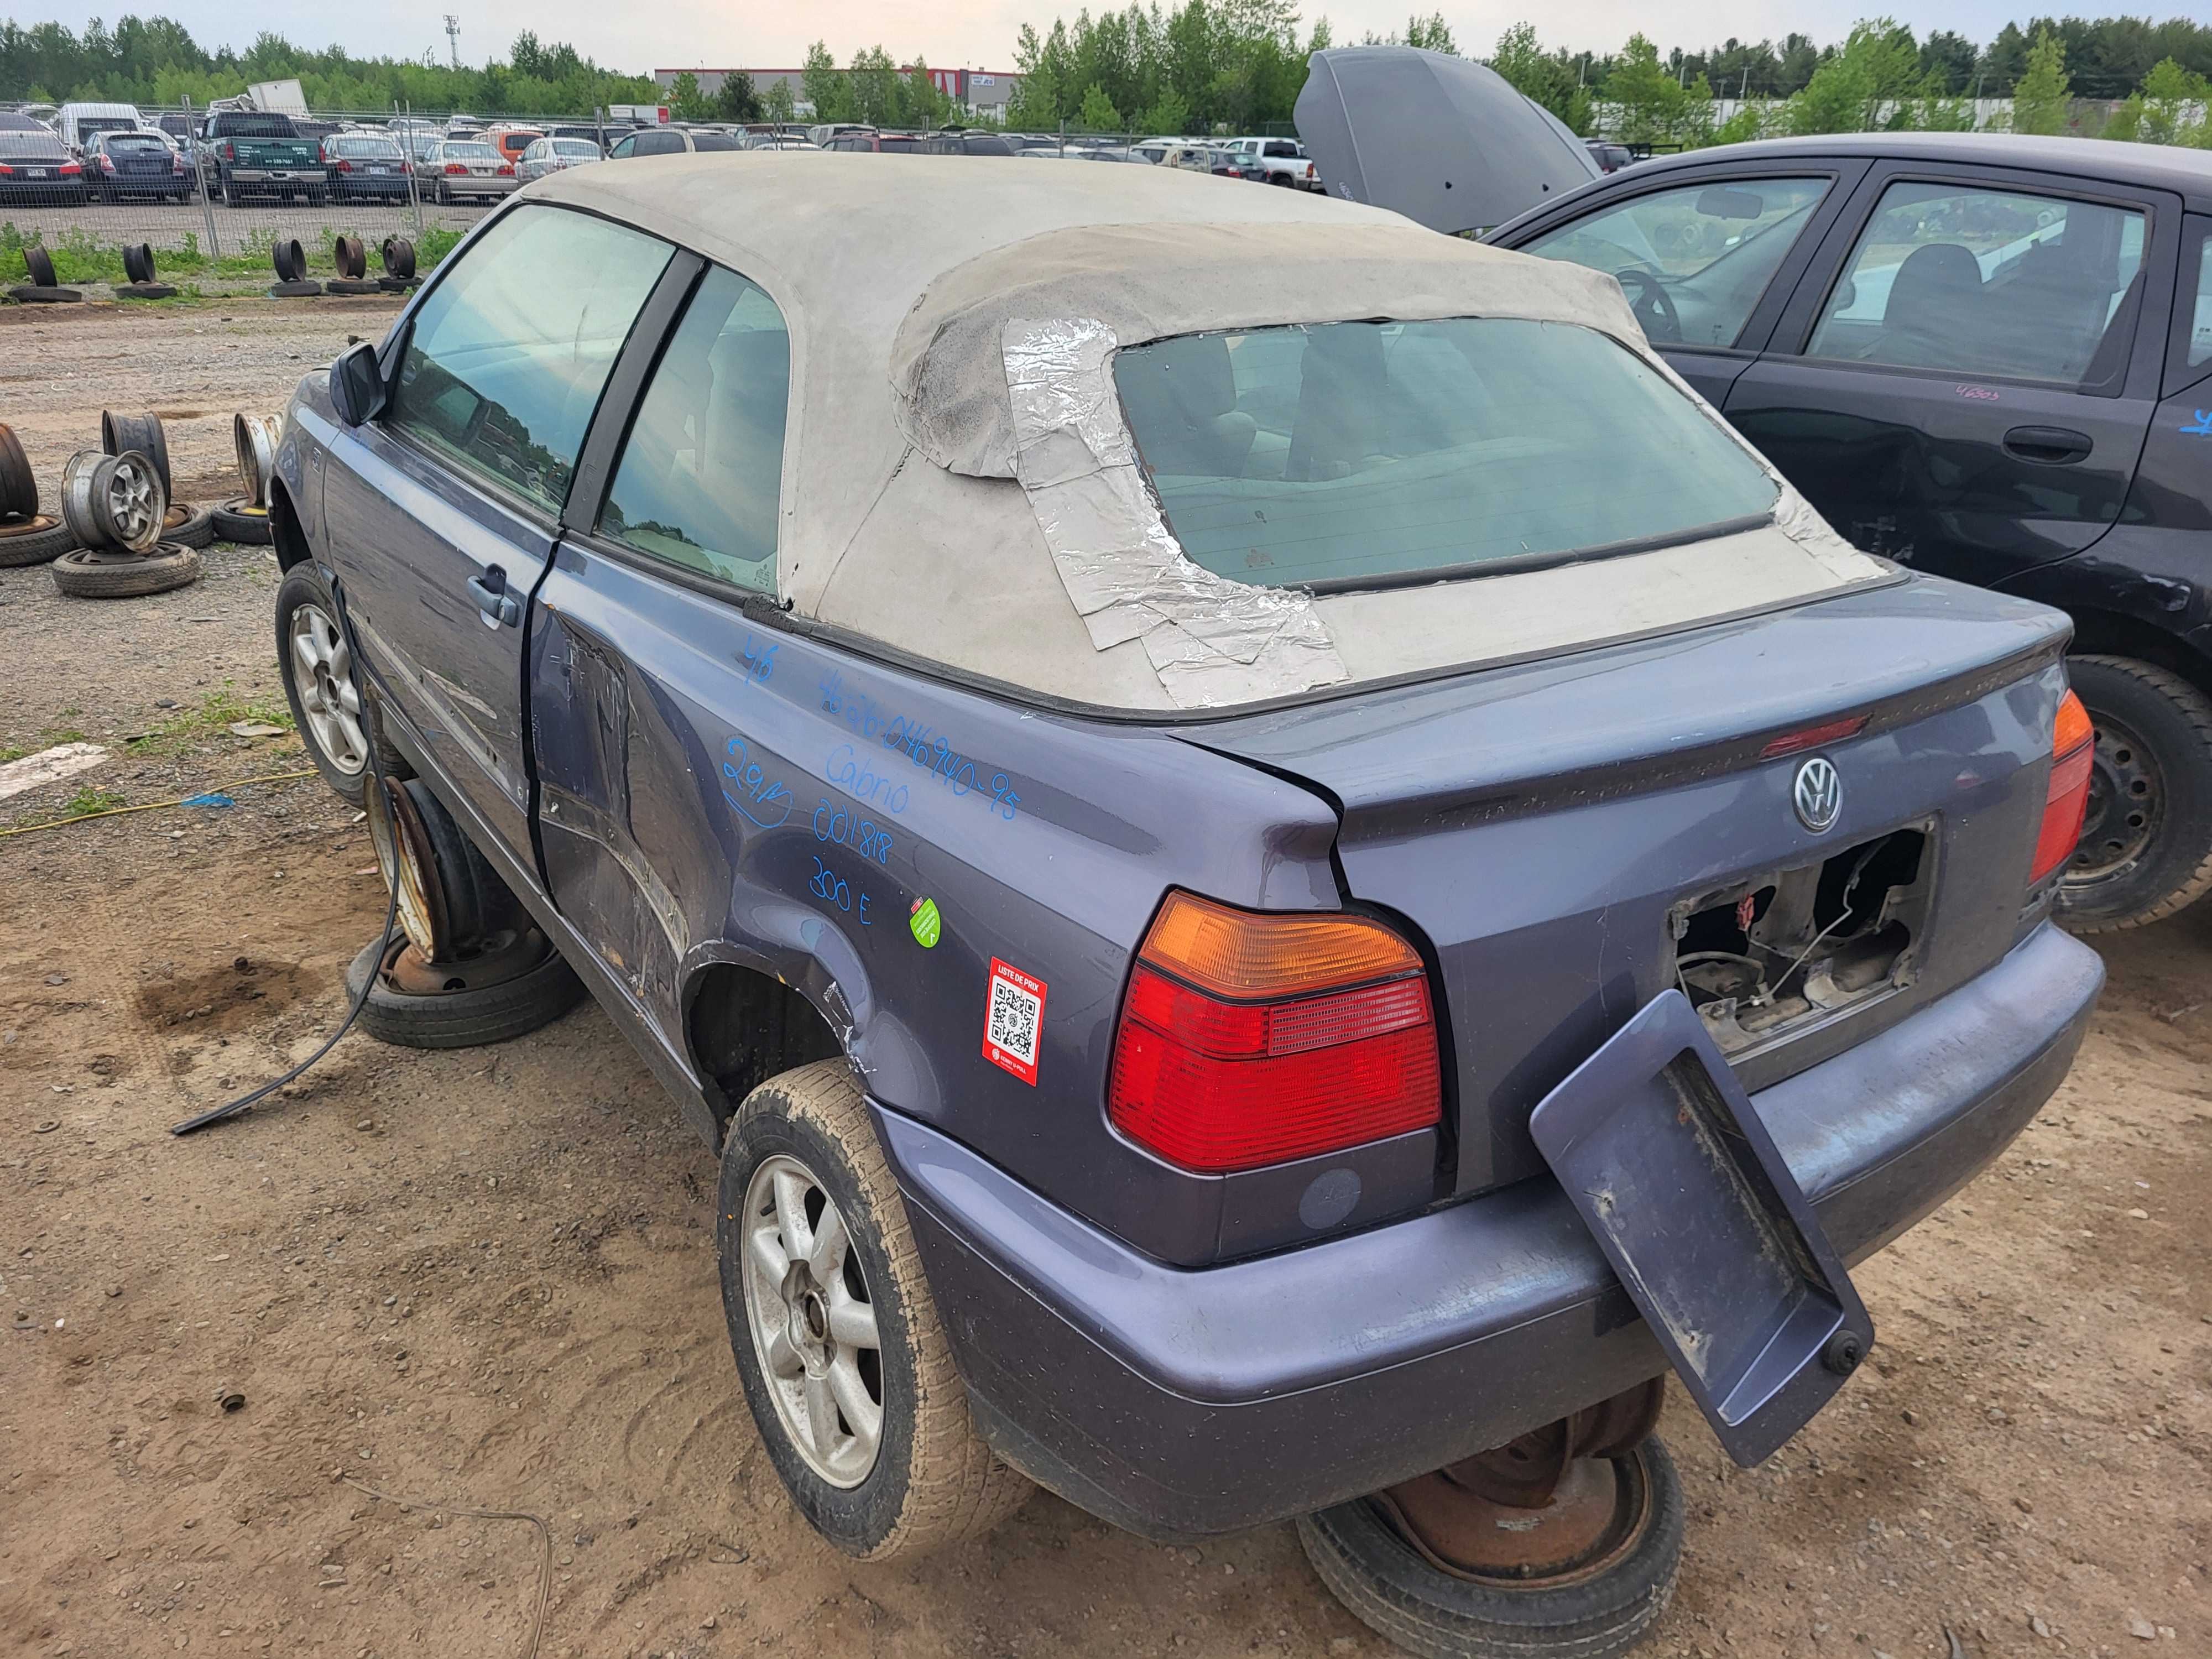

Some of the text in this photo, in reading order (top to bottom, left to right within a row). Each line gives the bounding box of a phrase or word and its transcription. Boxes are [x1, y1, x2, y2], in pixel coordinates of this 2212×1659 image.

[813, 798, 893, 864] 001818
[809, 856, 851, 911] 300
[859, 893, 872, 925] E
[998, 964, 1039, 992] LISTE DE PRIX
